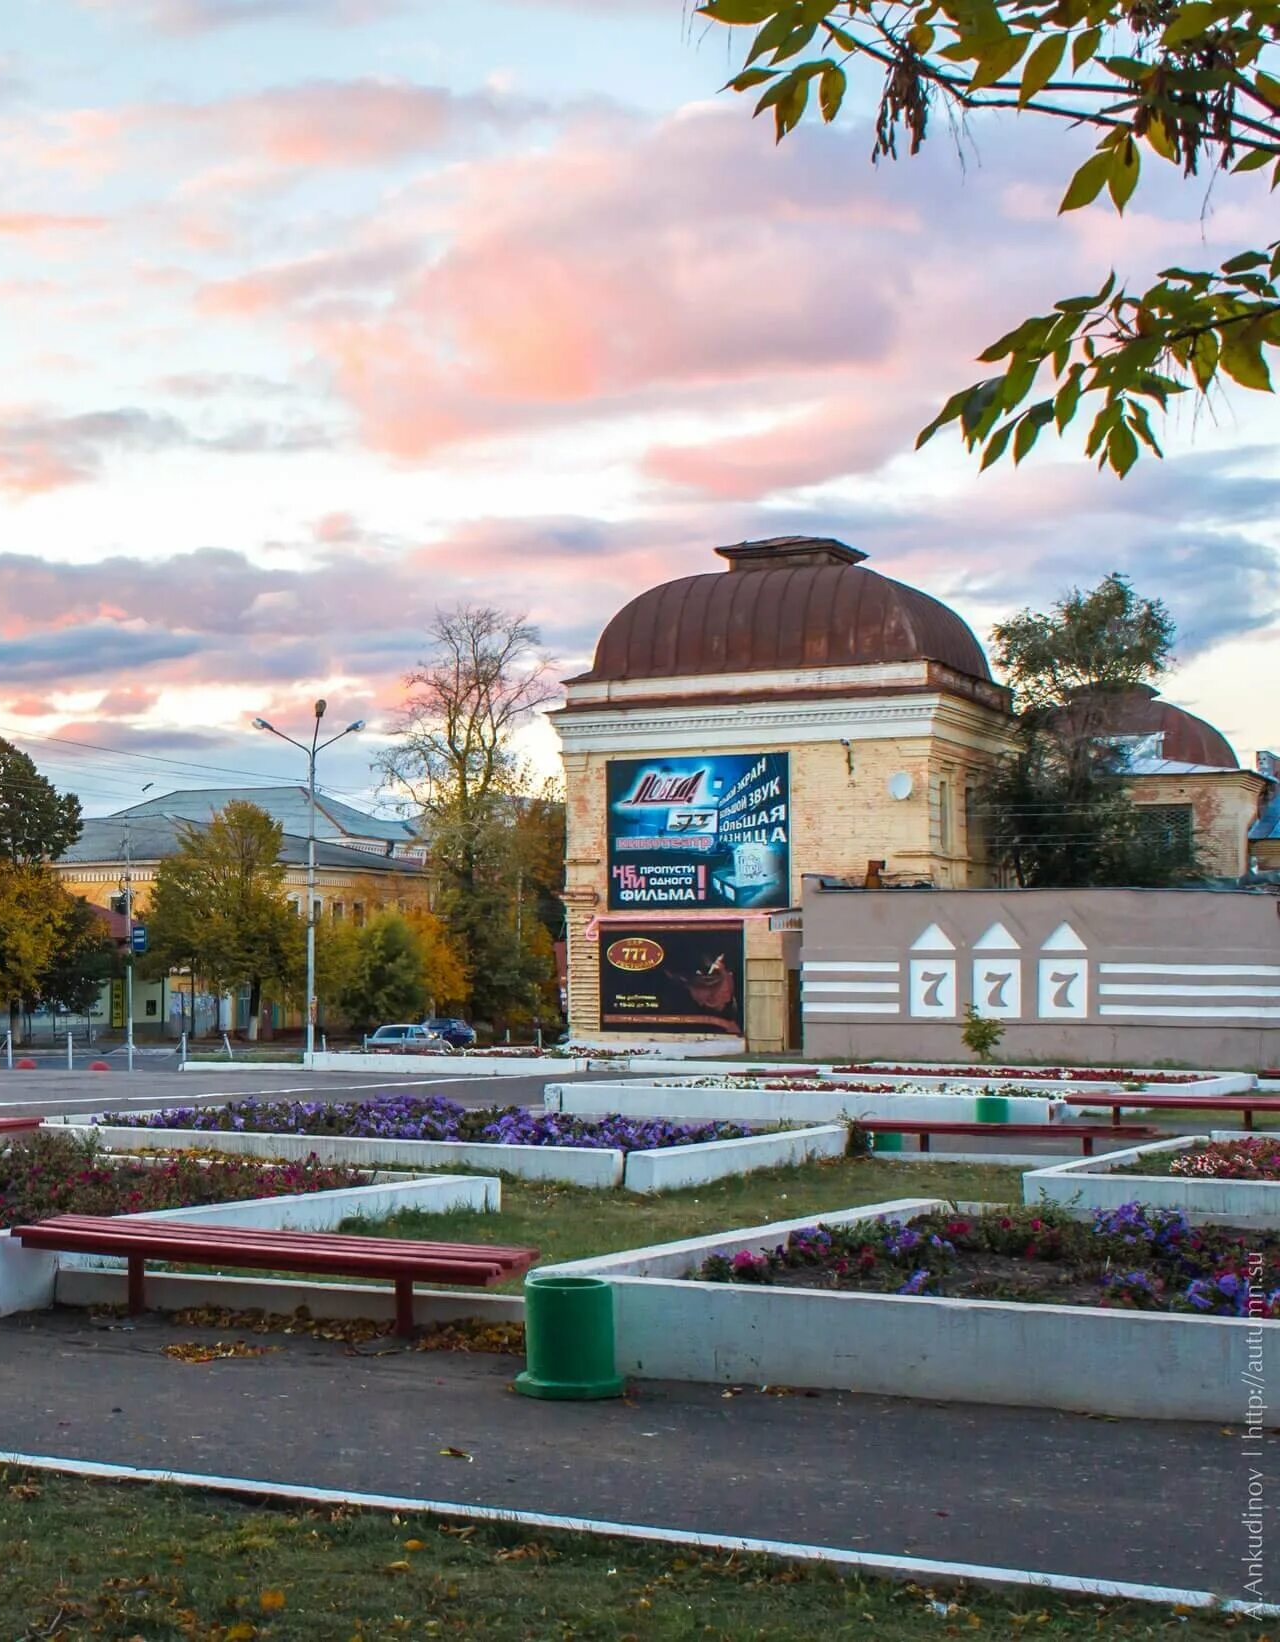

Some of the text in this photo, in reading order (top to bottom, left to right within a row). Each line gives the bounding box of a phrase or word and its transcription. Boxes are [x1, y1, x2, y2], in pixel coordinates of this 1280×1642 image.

[737, 756, 766, 793] ЭКРАН
[748, 775, 780, 807] ЗВУК
[719, 826, 787, 845] РАЗНИЦА
[612, 864, 696, 878] НЕ ПРОПУСТИ
[620, 876, 693, 889] НИ ОДНОГО
[620, 888, 696, 902] ФИЛЬМА
[622, 948, 647, 961] 777
